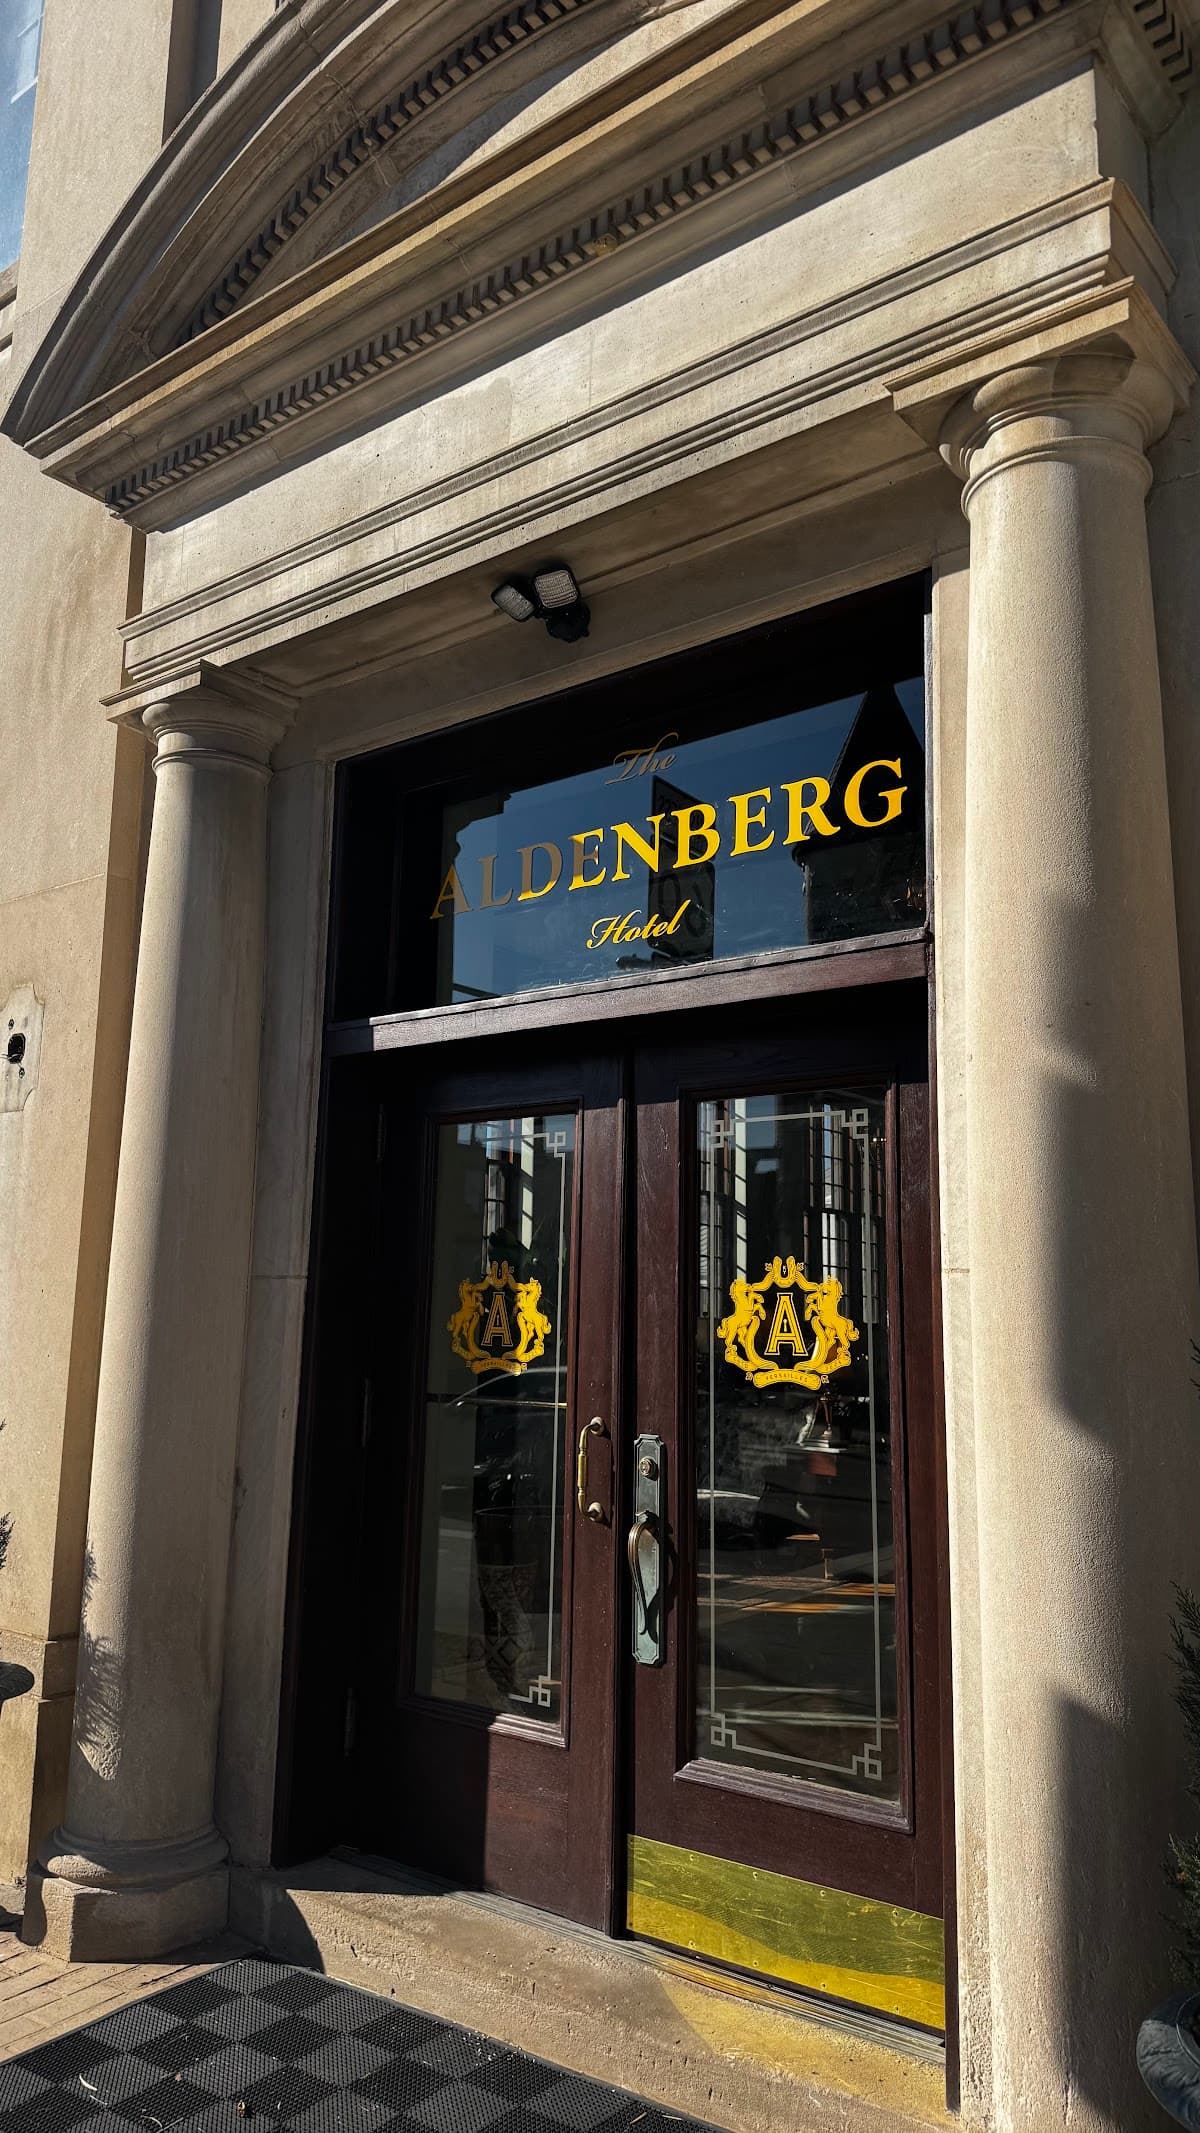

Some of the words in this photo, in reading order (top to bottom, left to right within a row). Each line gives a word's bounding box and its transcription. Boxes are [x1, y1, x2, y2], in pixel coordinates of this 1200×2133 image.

[604, 732, 679, 785] The
[429, 757, 908, 920] ALDENBERG
[586, 899, 692, 950] Hotel
[481, 1291, 513, 1347] A
[764, 1292, 809, 1357] A
